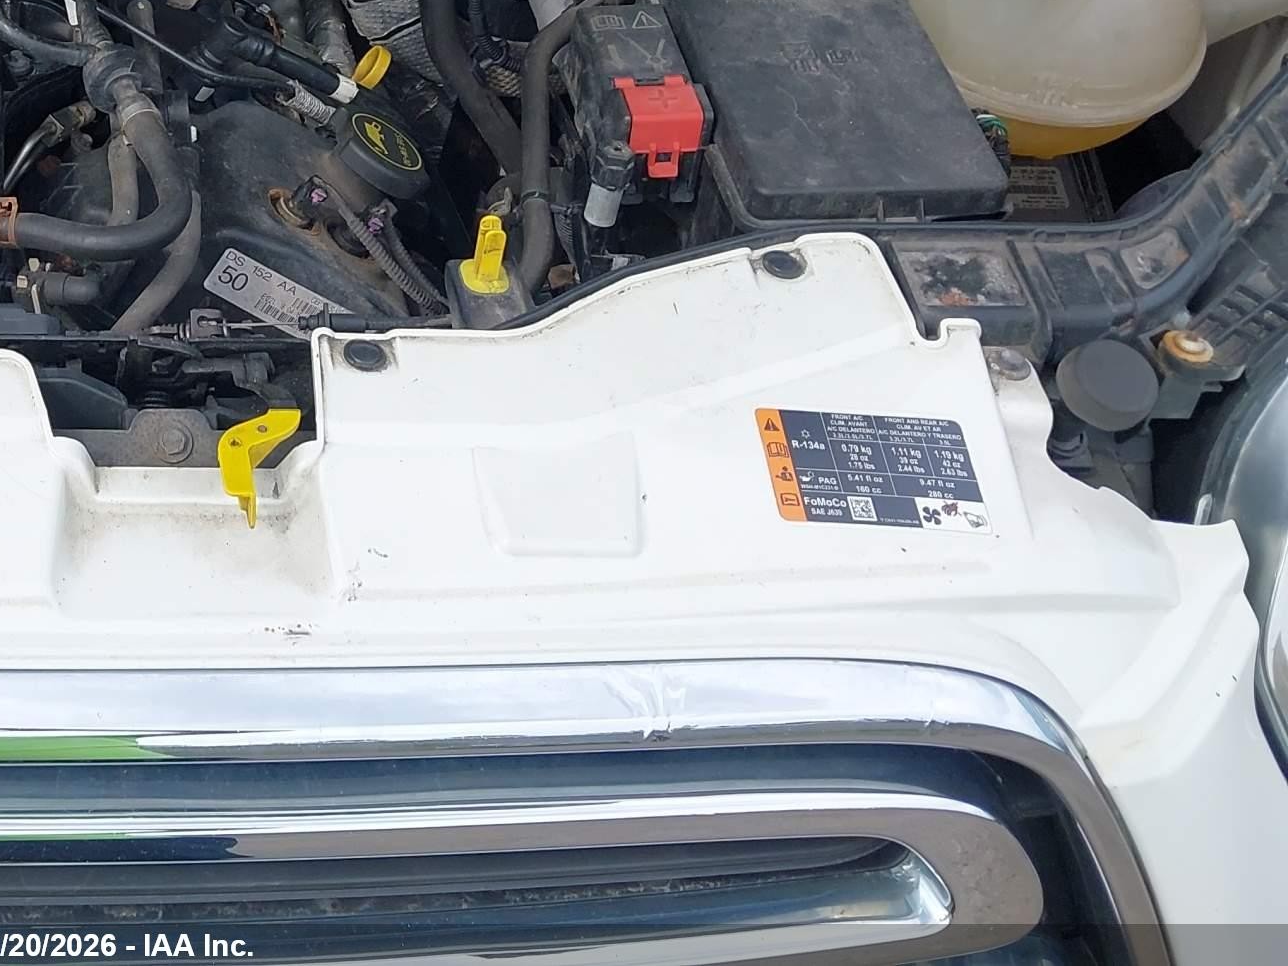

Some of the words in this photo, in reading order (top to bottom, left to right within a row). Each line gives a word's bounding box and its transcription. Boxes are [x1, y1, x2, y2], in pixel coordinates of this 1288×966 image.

[218, 265, 249, 291] 50
[225, 250, 246, 267] DS
[253, 265, 273, 283] 152
[277, 281, 297, 296] AA
[792, 439, 826, 451] R-134a
[841, 444, 859, 453] 0.79
[860, 445, 872, 455] kg
[849, 453, 859, 461] 28
[891, 447, 908, 456] 1.11
[910, 448, 922, 458] kg
[934, 450, 952, 459] 1.19
[953, 451, 964, 462] kg
[899, 456, 908, 464] 39
[848, 461, 863, 469] 1.75
[864, 462, 875, 470] lbs
[897, 464, 912, 472] 2.44
[913, 465, 925, 473] lbs
[940, 467, 955, 475] 2.63
[956, 468, 968, 477] lbs
[919, 478, 936, 486] 9.47
[938, 479, 944, 487] fl
[928, 490, 942, 498] 280
[804, 497, 847, 507] FoMoCo
[811, 507, 826, 515] SAE
